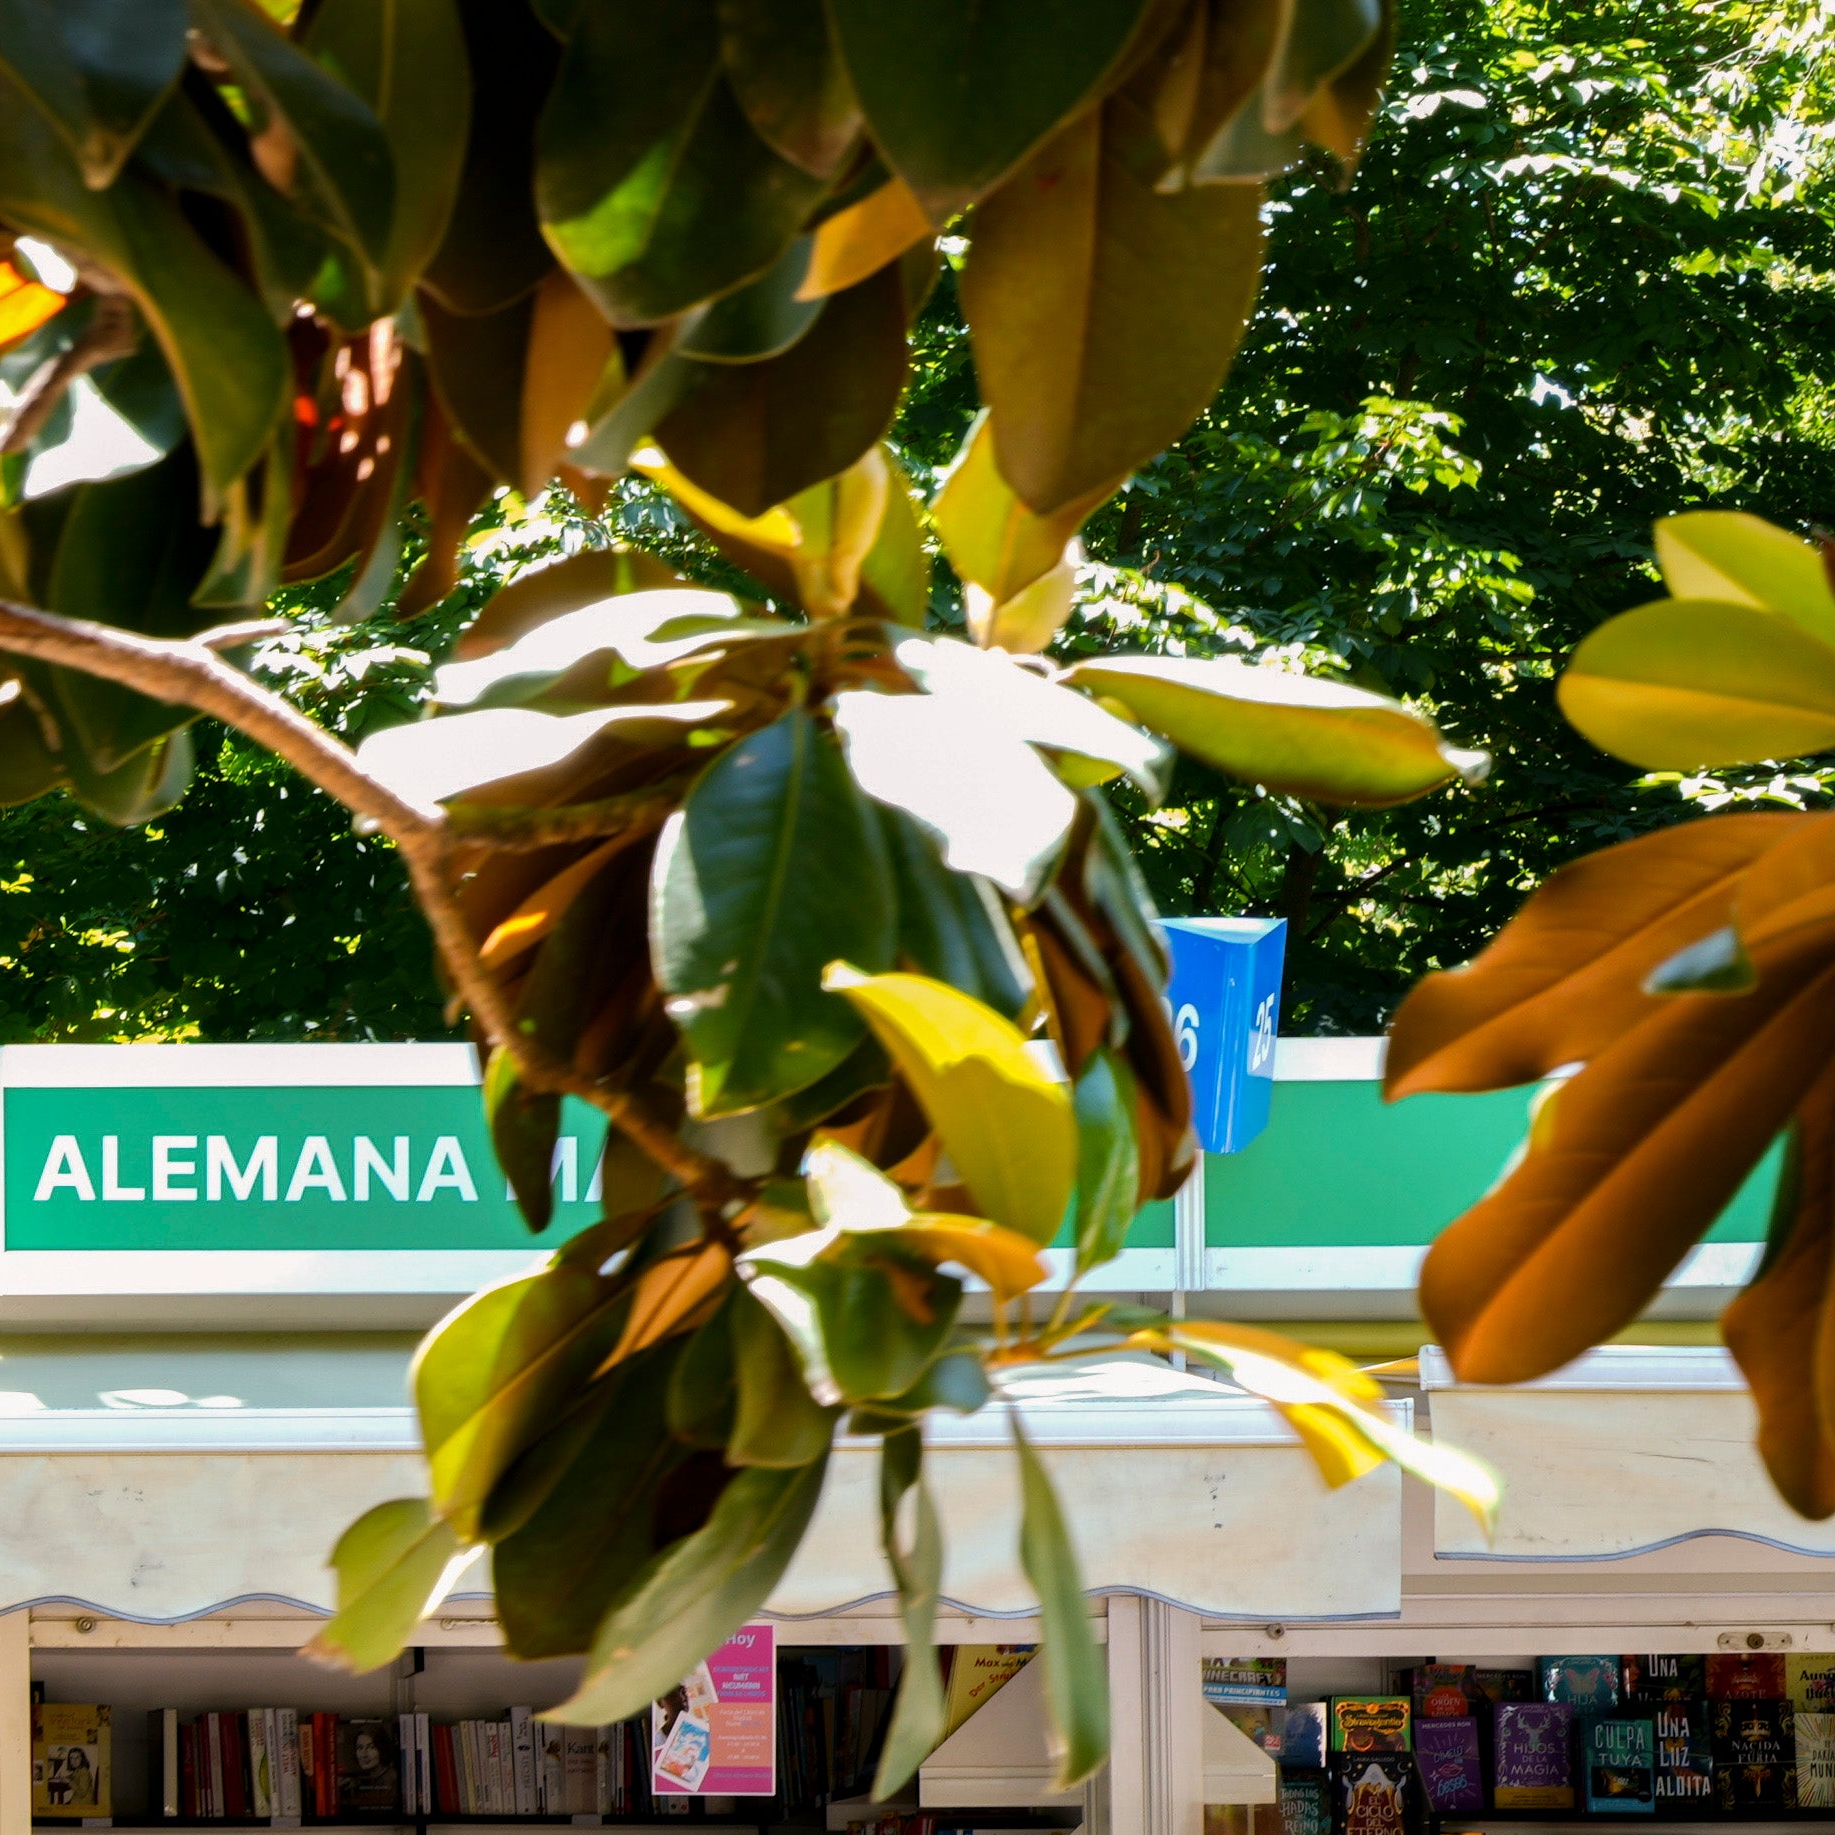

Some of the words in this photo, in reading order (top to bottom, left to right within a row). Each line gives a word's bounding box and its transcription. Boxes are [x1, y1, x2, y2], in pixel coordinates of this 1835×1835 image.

[1163, 997, 1201, 1073] 6
[1252, 993, 1276, 1072] 25
[33, 1135, 479, 1203] ALEMANA
[1225, 1687, 1280, 1697] PRINCIPIANTES
[1657, 1711, 1691, 1738] UNA
[1595, 1724, 1645, 1751] CULPA
[1731, 1740, 1782, 1752] NACIDA
[1514, 1743, 1556, 1754] HIJOS
[1598, 1753, 1643, 1767] TUYA
[1655, 1776, 1712, 1797] ALDITA
[1355, 1806, 1395, 1822] CICLO
[1366, 1818, 1385, 1827] DEL
